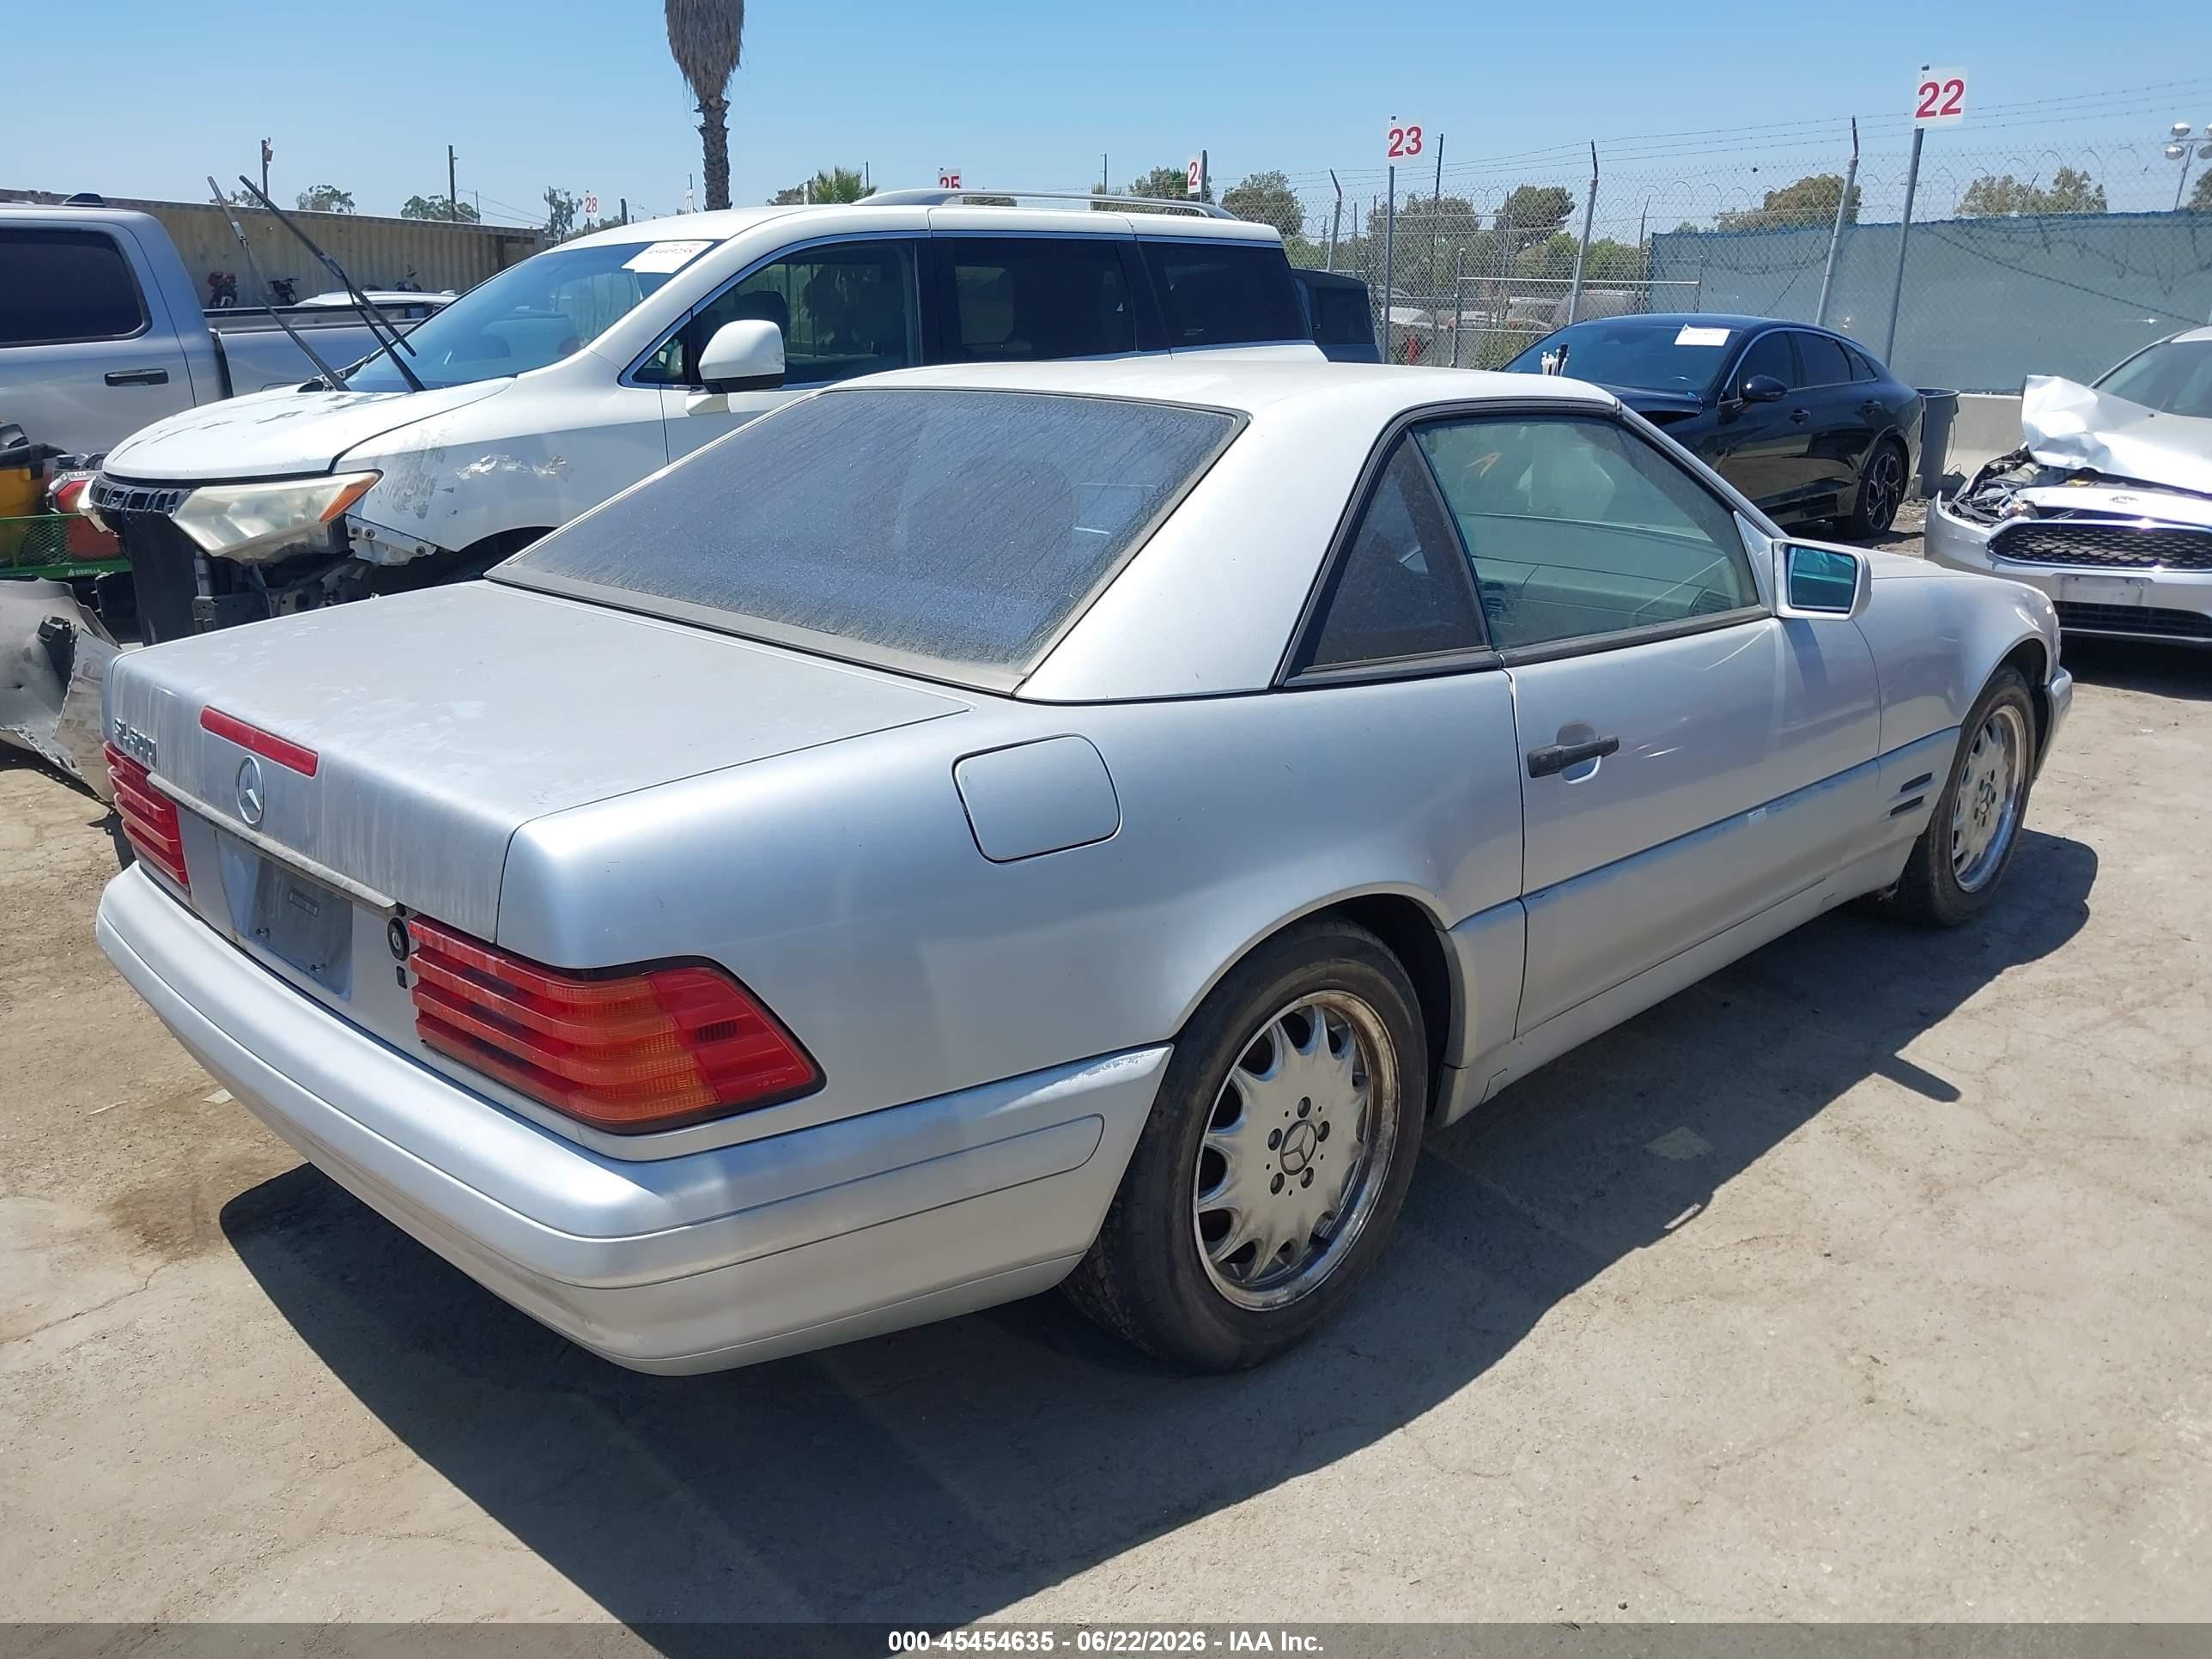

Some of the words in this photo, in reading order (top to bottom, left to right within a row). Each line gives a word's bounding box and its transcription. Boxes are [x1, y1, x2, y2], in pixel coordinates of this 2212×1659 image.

[1915, 79, 1965, 118] 22
[1388, 126, 1422, 157] 23
[585, 197, 598, 213] 28
